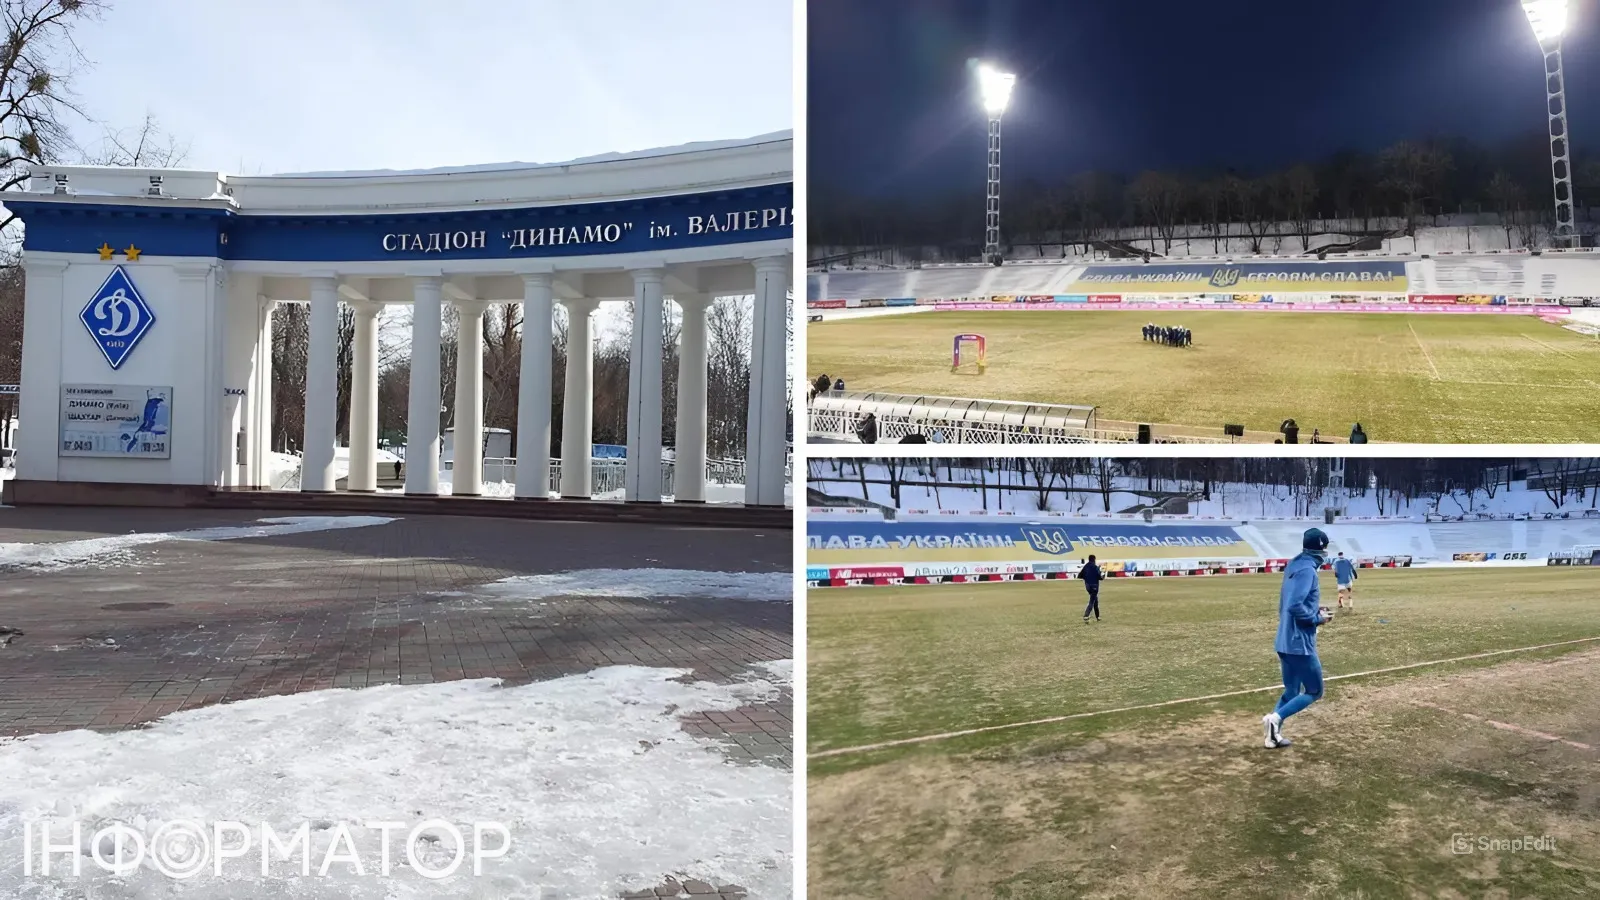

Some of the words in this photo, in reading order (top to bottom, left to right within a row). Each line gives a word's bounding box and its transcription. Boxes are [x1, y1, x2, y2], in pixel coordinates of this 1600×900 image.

[382, 230, 486, 253] СТАДІОН
[648, 220, 678, 239] ім.
[687, 207, 793, 235] ВАЛЕРІ
